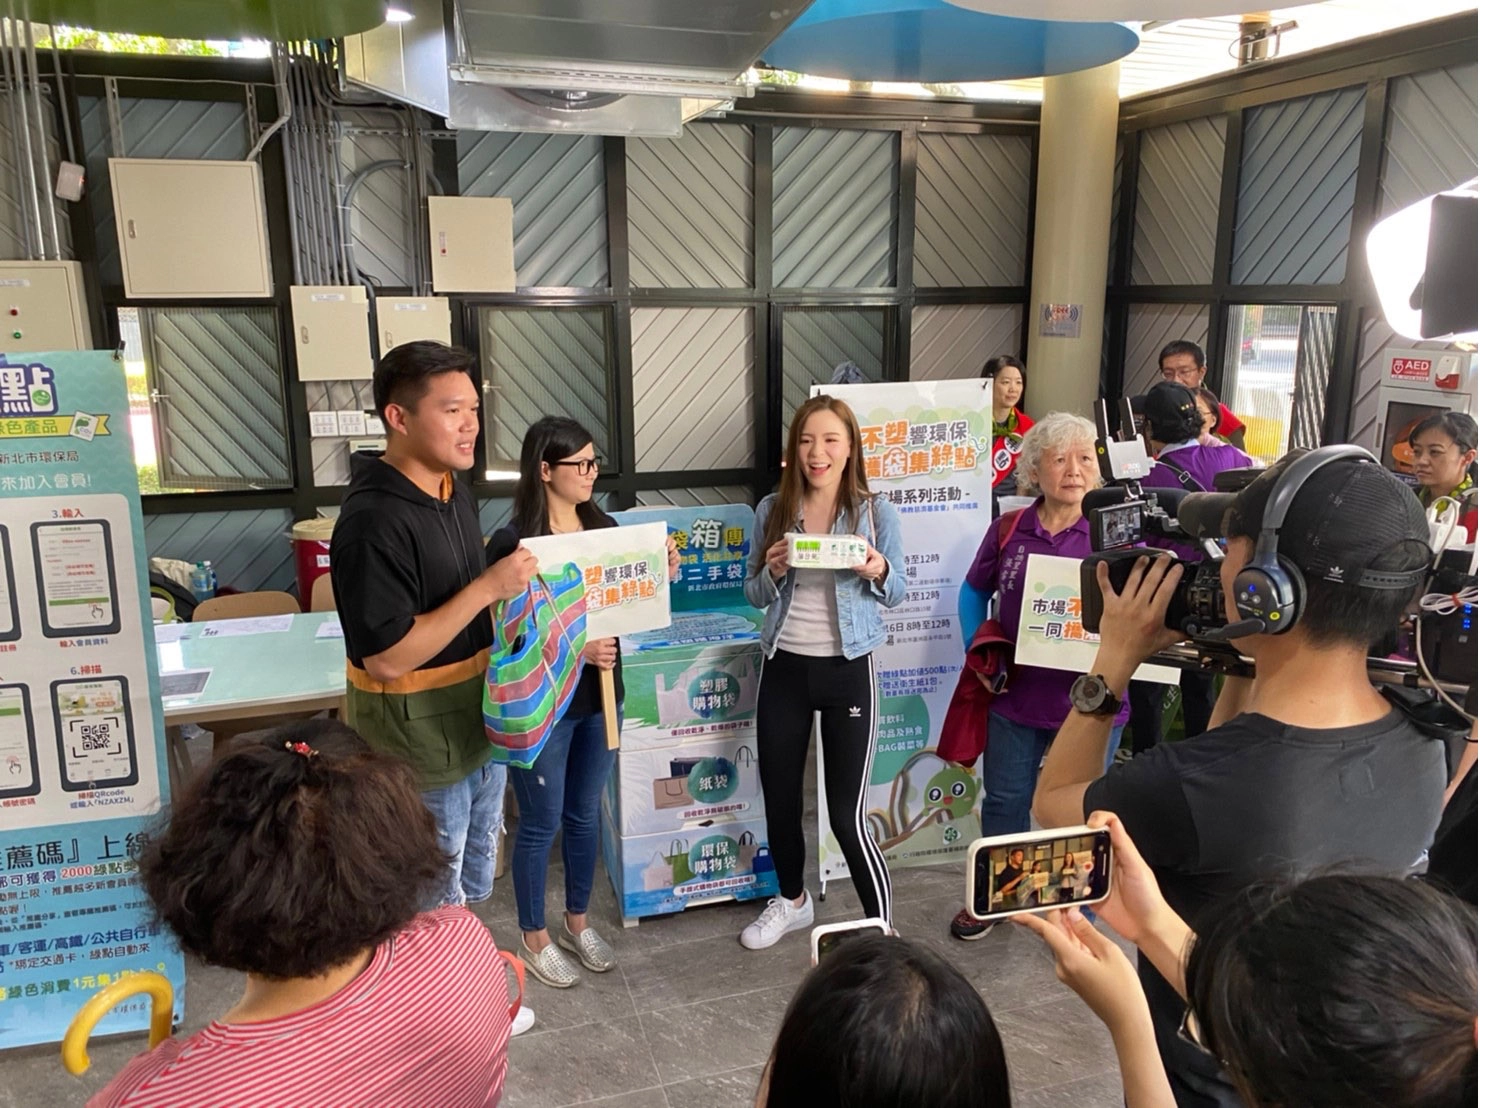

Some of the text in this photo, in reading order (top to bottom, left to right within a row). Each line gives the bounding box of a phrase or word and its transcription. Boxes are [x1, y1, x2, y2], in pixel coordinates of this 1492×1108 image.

[1405, 360, 1429, 371] AED
[0, 419, 58, 435] 色產品
[861, 421, 967, 450] 不塑響環保
[881, 487, 962, 505] 場系列活動
[584, 561, 648, 586] 塑響環保
